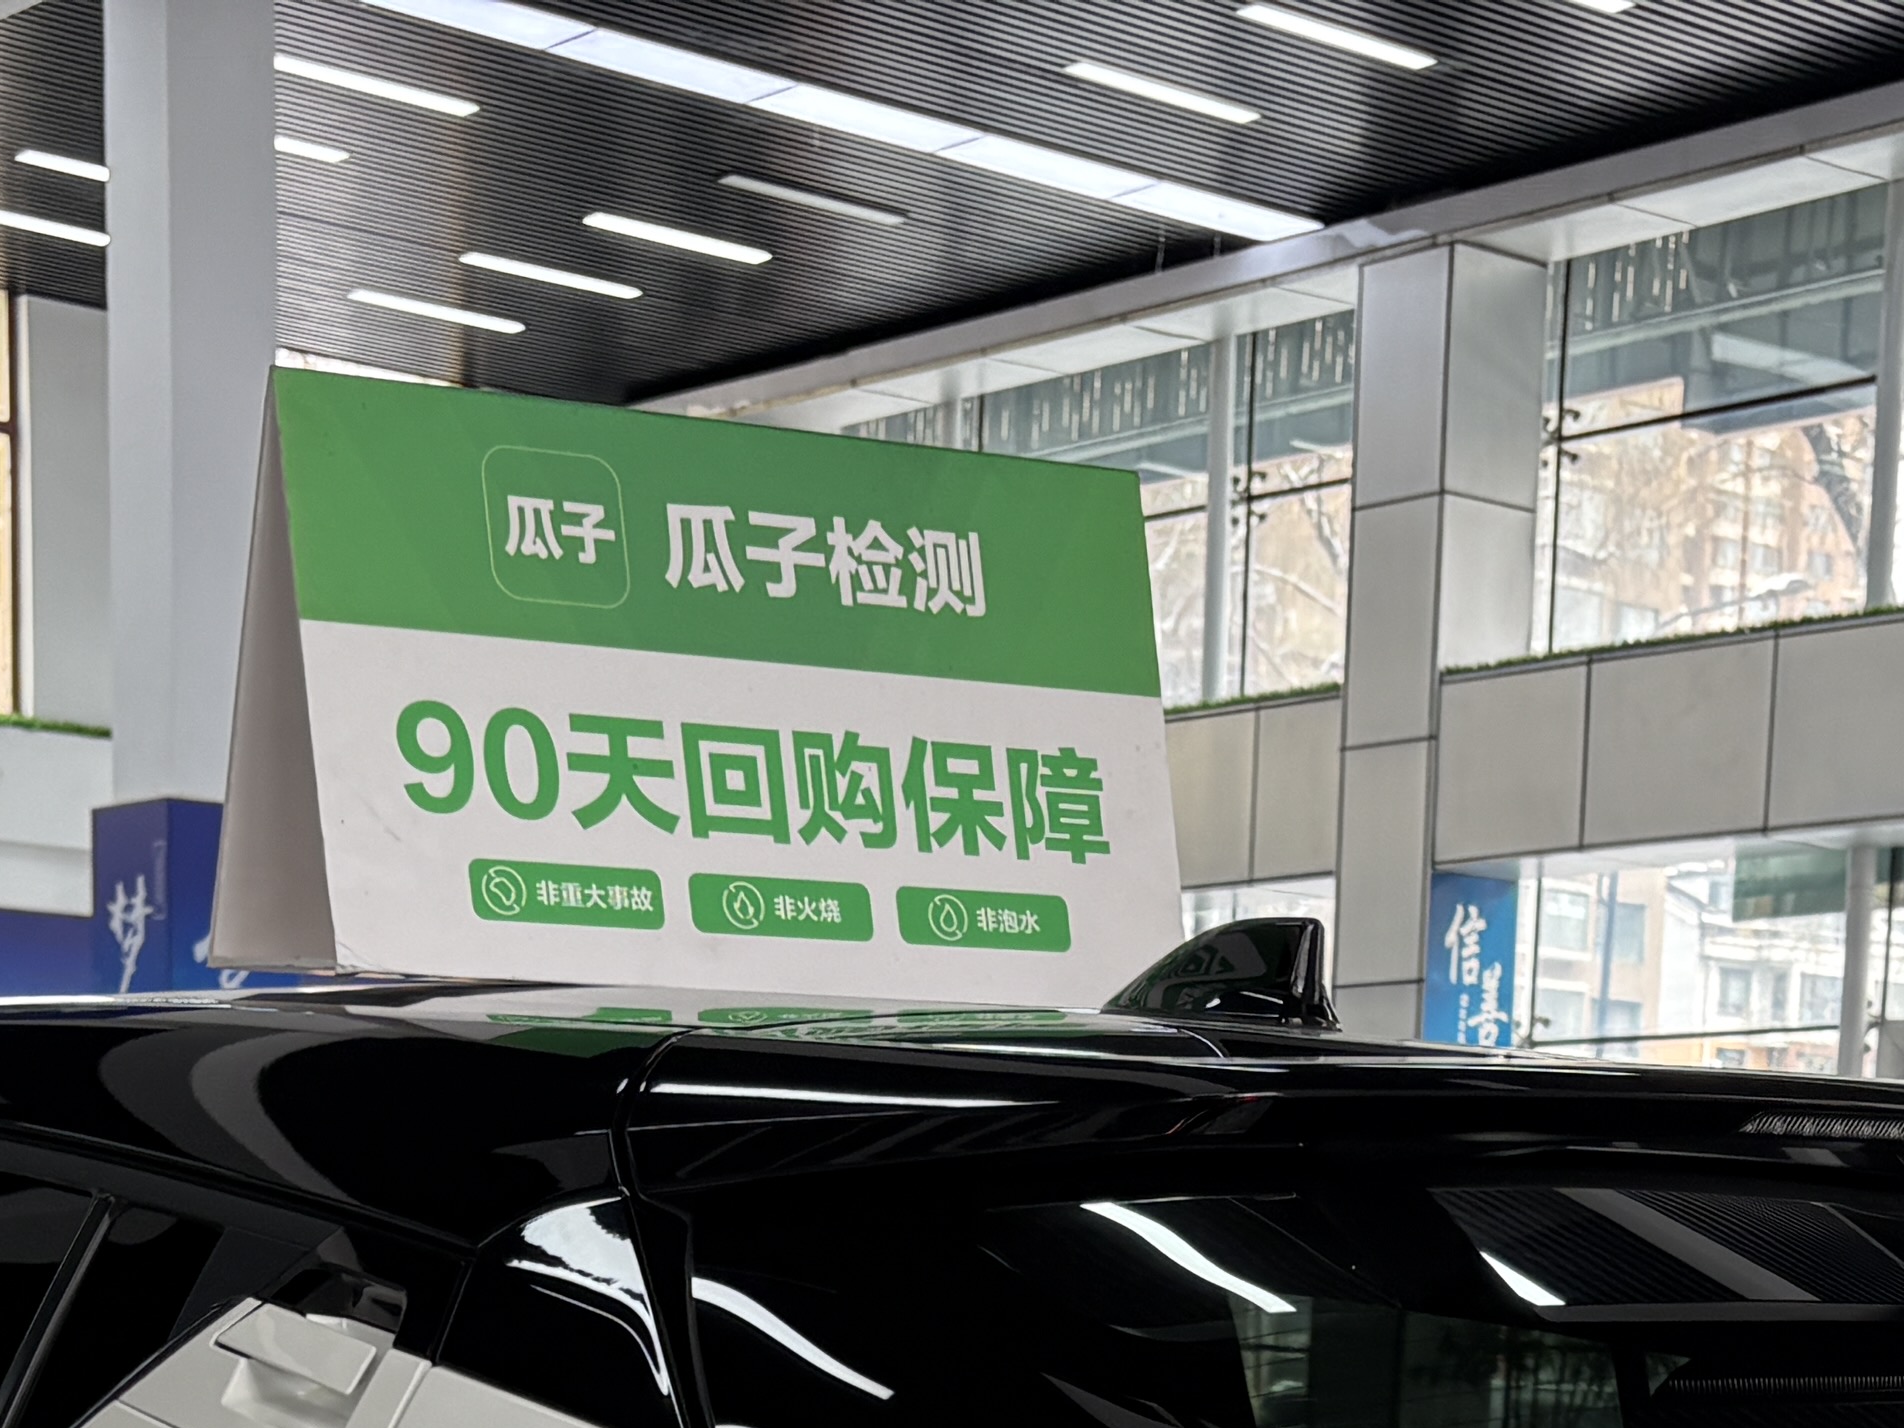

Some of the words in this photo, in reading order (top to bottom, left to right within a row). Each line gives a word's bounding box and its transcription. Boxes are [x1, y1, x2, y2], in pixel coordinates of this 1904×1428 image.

[504, 494, 617, 565] 瓜子
[664, 503, 988, 619] 瓜子检测
[394, 699, 1113, 867] 90天回购保障
[535, 880, 654, 912] 非重大事故
[773, 895, 842, 924] 非火烧
[976, 907, 1040, 936] 非泡水
